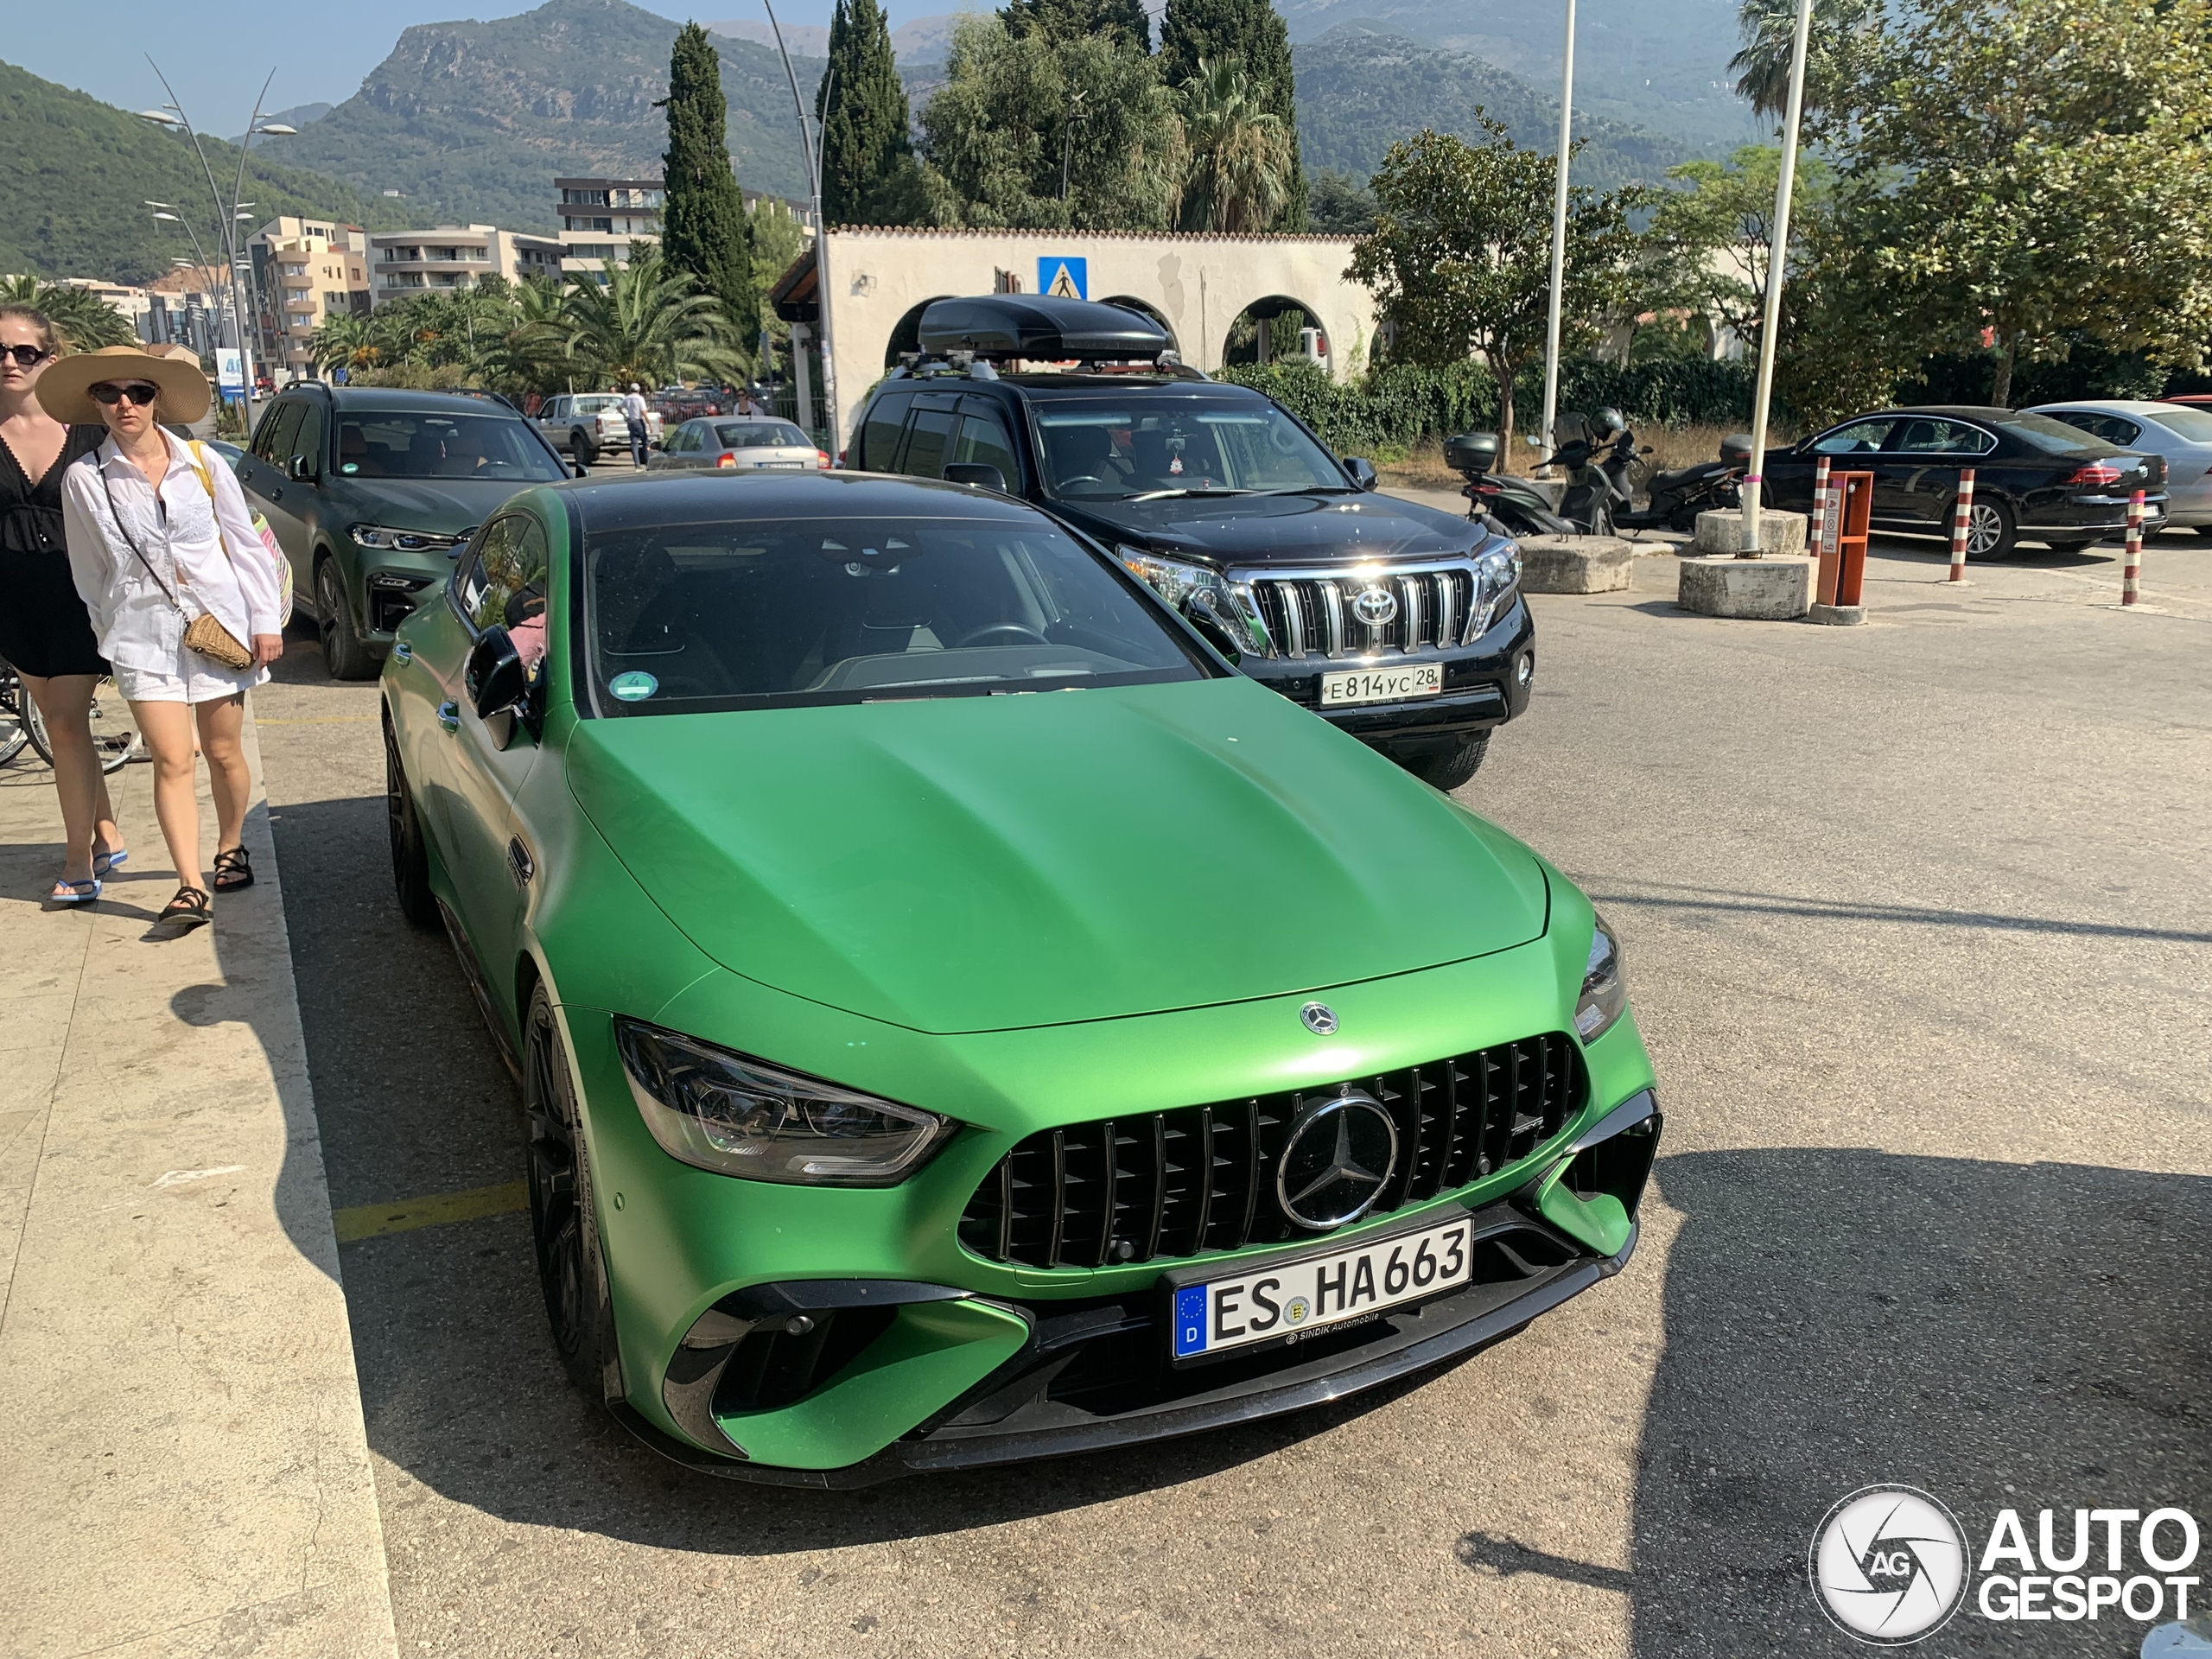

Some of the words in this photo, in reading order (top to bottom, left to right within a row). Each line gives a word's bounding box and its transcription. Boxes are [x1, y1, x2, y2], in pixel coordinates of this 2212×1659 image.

[628, 675, 639, 685] 4
[1416, 669, 1434, 685] 28
[1215, 1278, 1280, 1340] ES
[1300, 1325, 1330, 1340] SINDIK
[1332, 1313, 1379, 1332] Automobile
[1186, 1327, 1198, 1343] D
